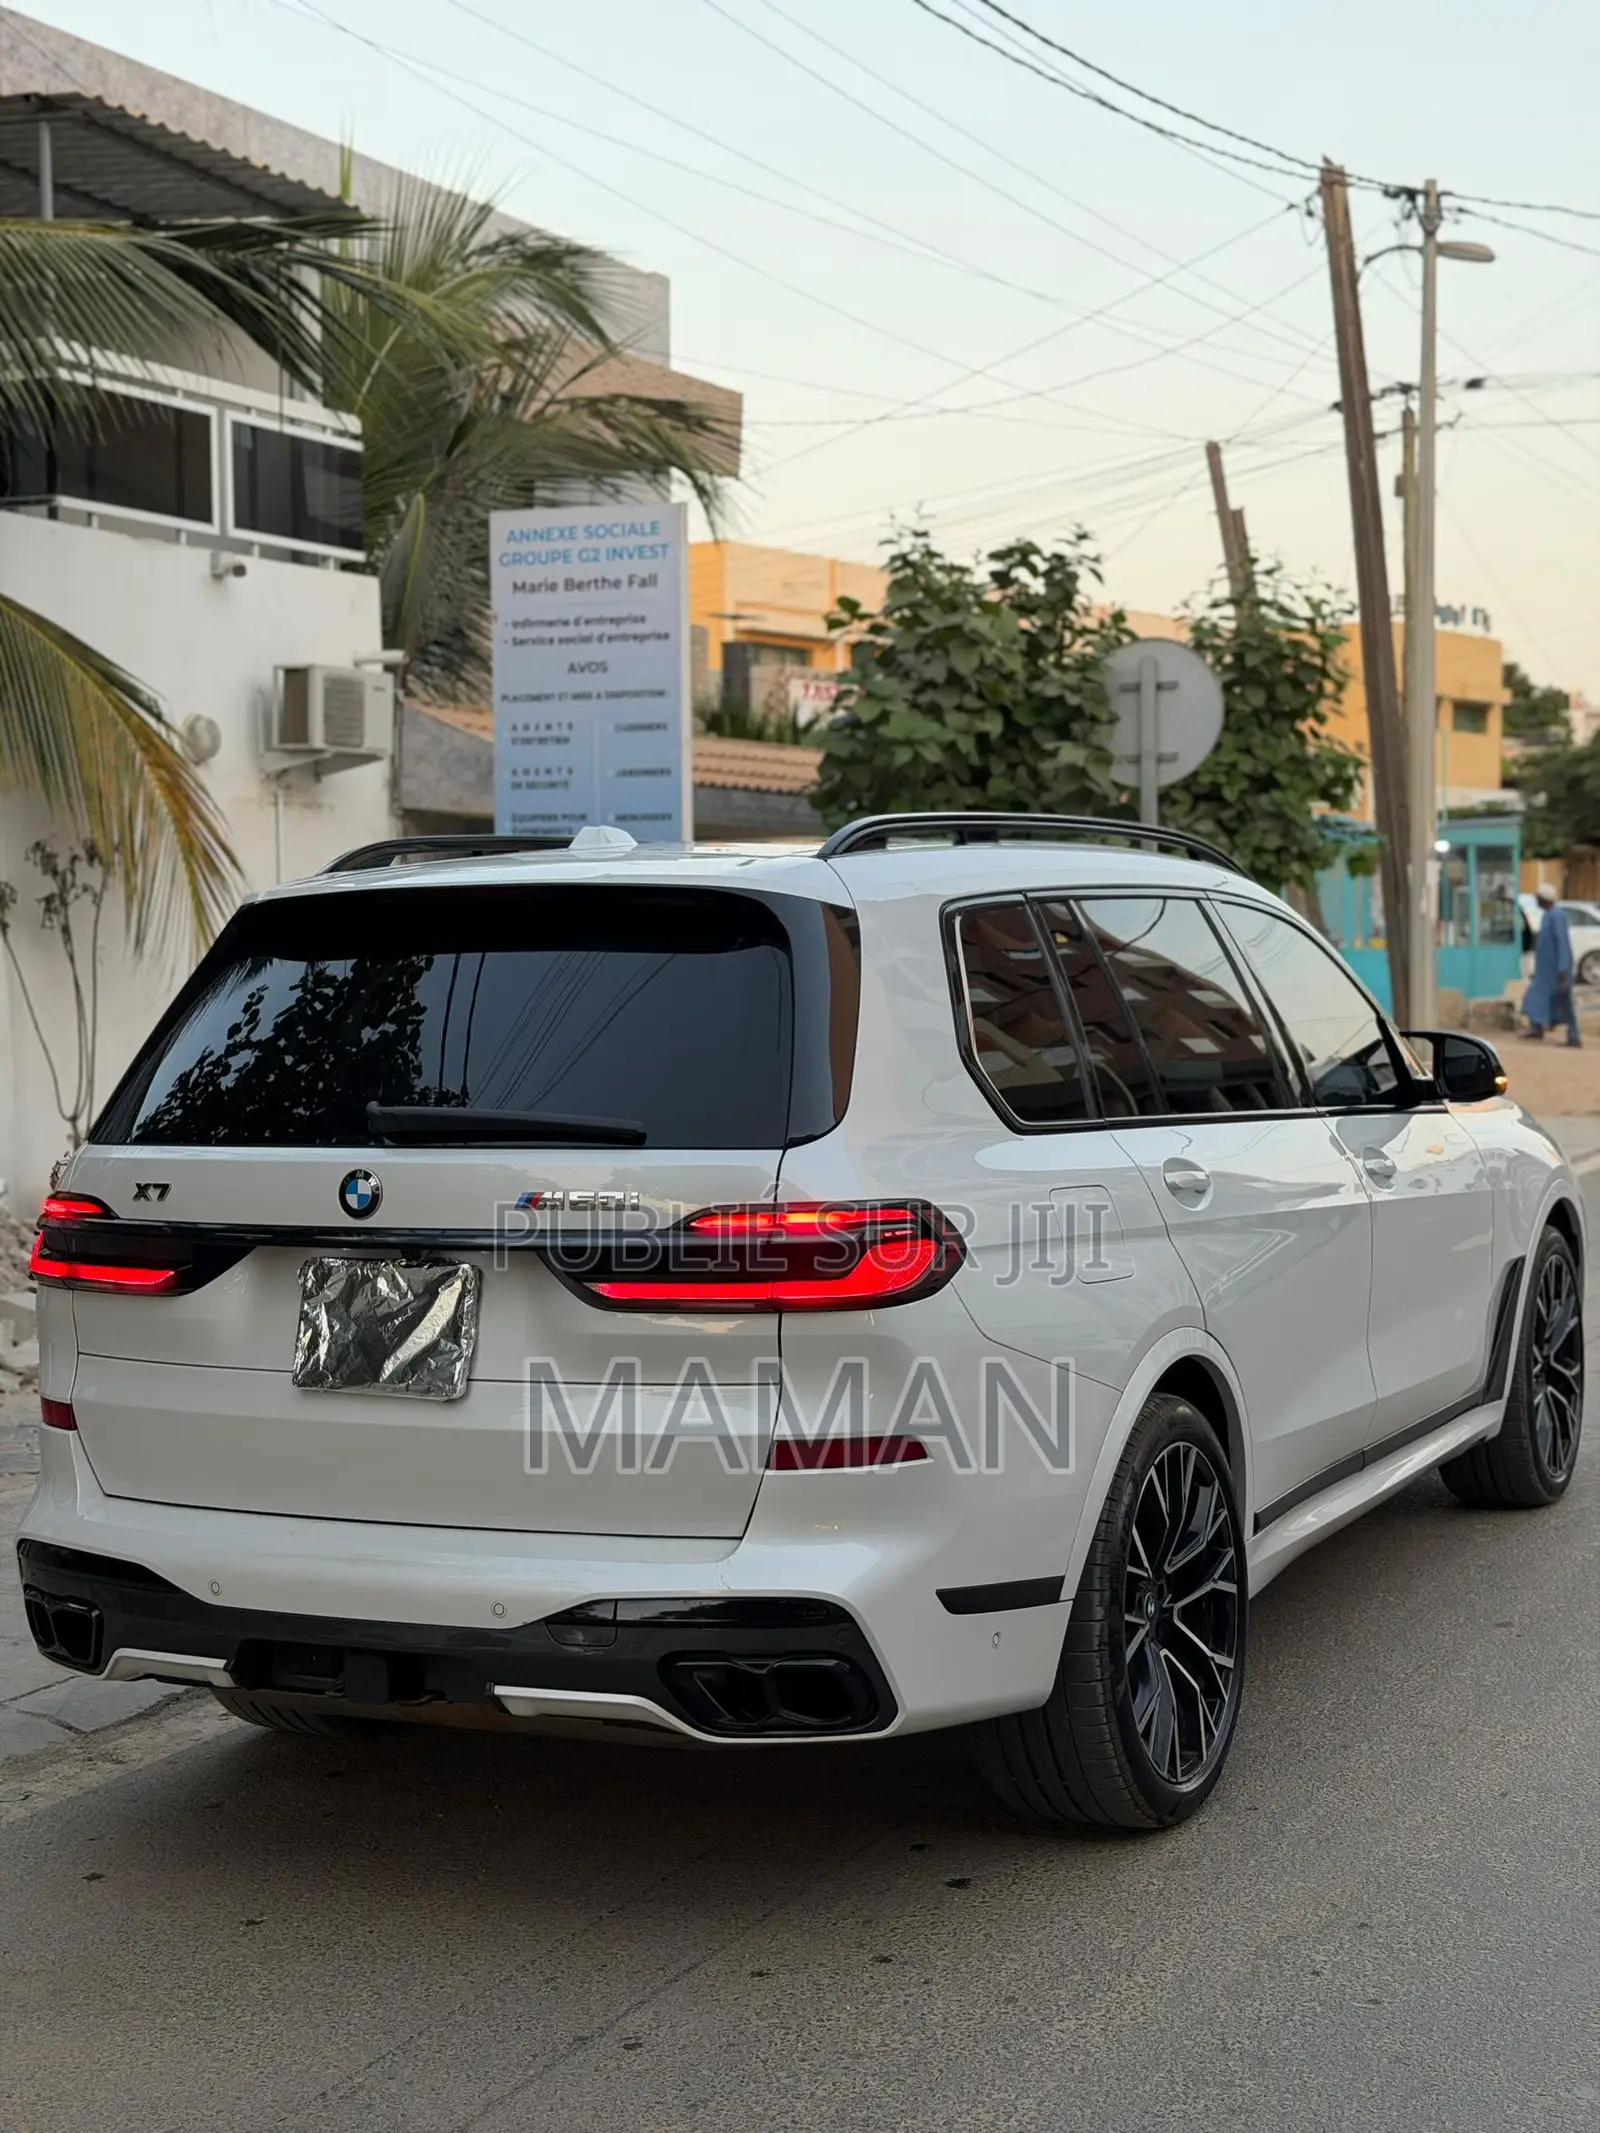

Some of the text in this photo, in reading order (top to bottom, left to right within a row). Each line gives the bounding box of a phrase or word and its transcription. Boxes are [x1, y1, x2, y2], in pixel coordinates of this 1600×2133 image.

[506, 520, 660, 544] ANNEXE SOCIALE
[499, 543, 670, 567] GROUPE G2 INVEST
[512, 573, 658, 595] Marie Berthe Fall
[511, 634, 554, 647] Service
[567, 661, 608, 675] AVOS
[132, 1182, 172, 1202] X7
